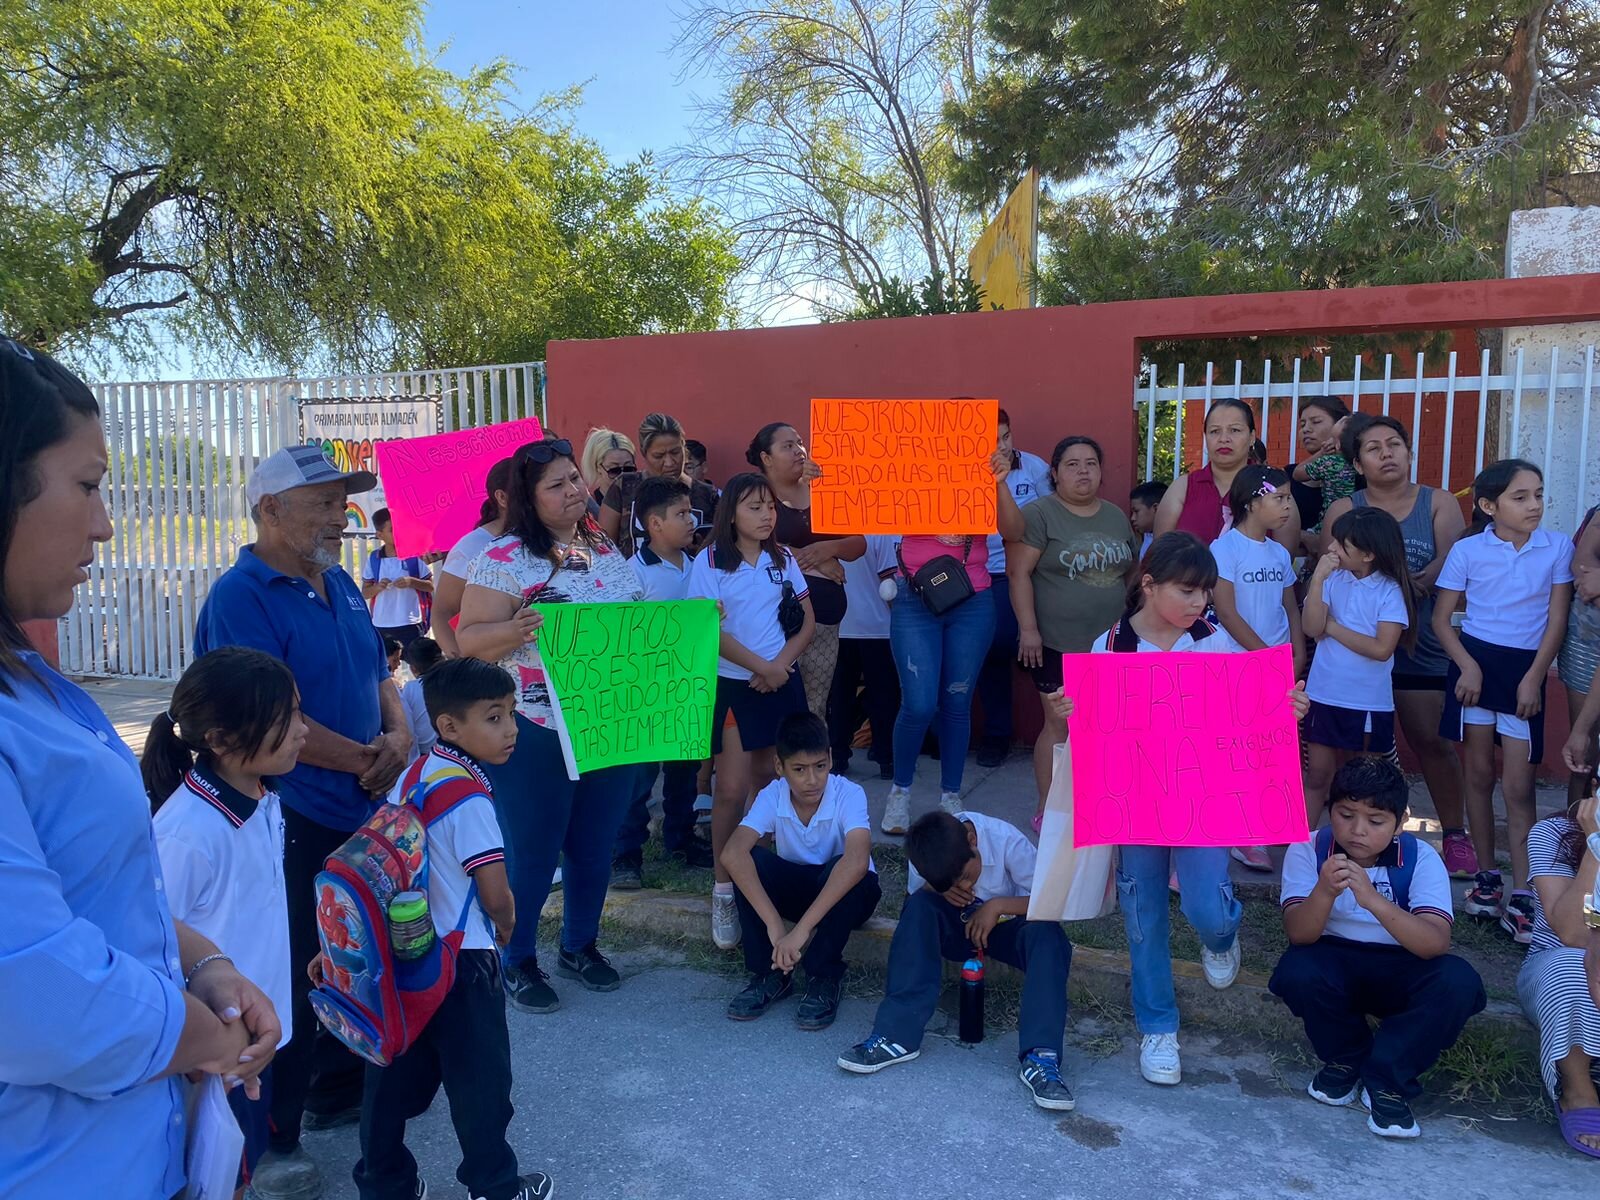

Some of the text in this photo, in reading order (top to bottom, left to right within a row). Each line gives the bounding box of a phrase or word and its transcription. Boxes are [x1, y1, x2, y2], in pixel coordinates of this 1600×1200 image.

[314, 408, 418, 426] PRIMARIA NUEVA ALMADÉN
[812, 400, 988, 435] NUESTROS NIÑOS
[385, 418, 543, 479] Nesecitamos
[812, 432, 990, 461] ESTAN SUFRIENDO
[886, 462, 899, 482] A
[903, 463, 933, 483] LAS
[938, 461, 994, 486] ALTAS
[402, 483, 455, 517] La
[812, 486, 996, 527] TEMPERATURAS
[1242, 567, 1284, 584] adida
[537, 604, 682, 658] NUESTROS
[610, 645, 696, 687] ESTAN
[665, 677, 711, 705] POR
[1077, 649, 1288, 735] QUEREMOS
[574, 724, 610, 763] LTAS
[679, 738, 708, 760] RAS
[1103, 736, 1208, 798] UNA
[1230, 750, 1279, 773] LUZ
[189, 768, 221, 797] MADEN
[1075, 778, 1307, 845] SOLUCIÓN
